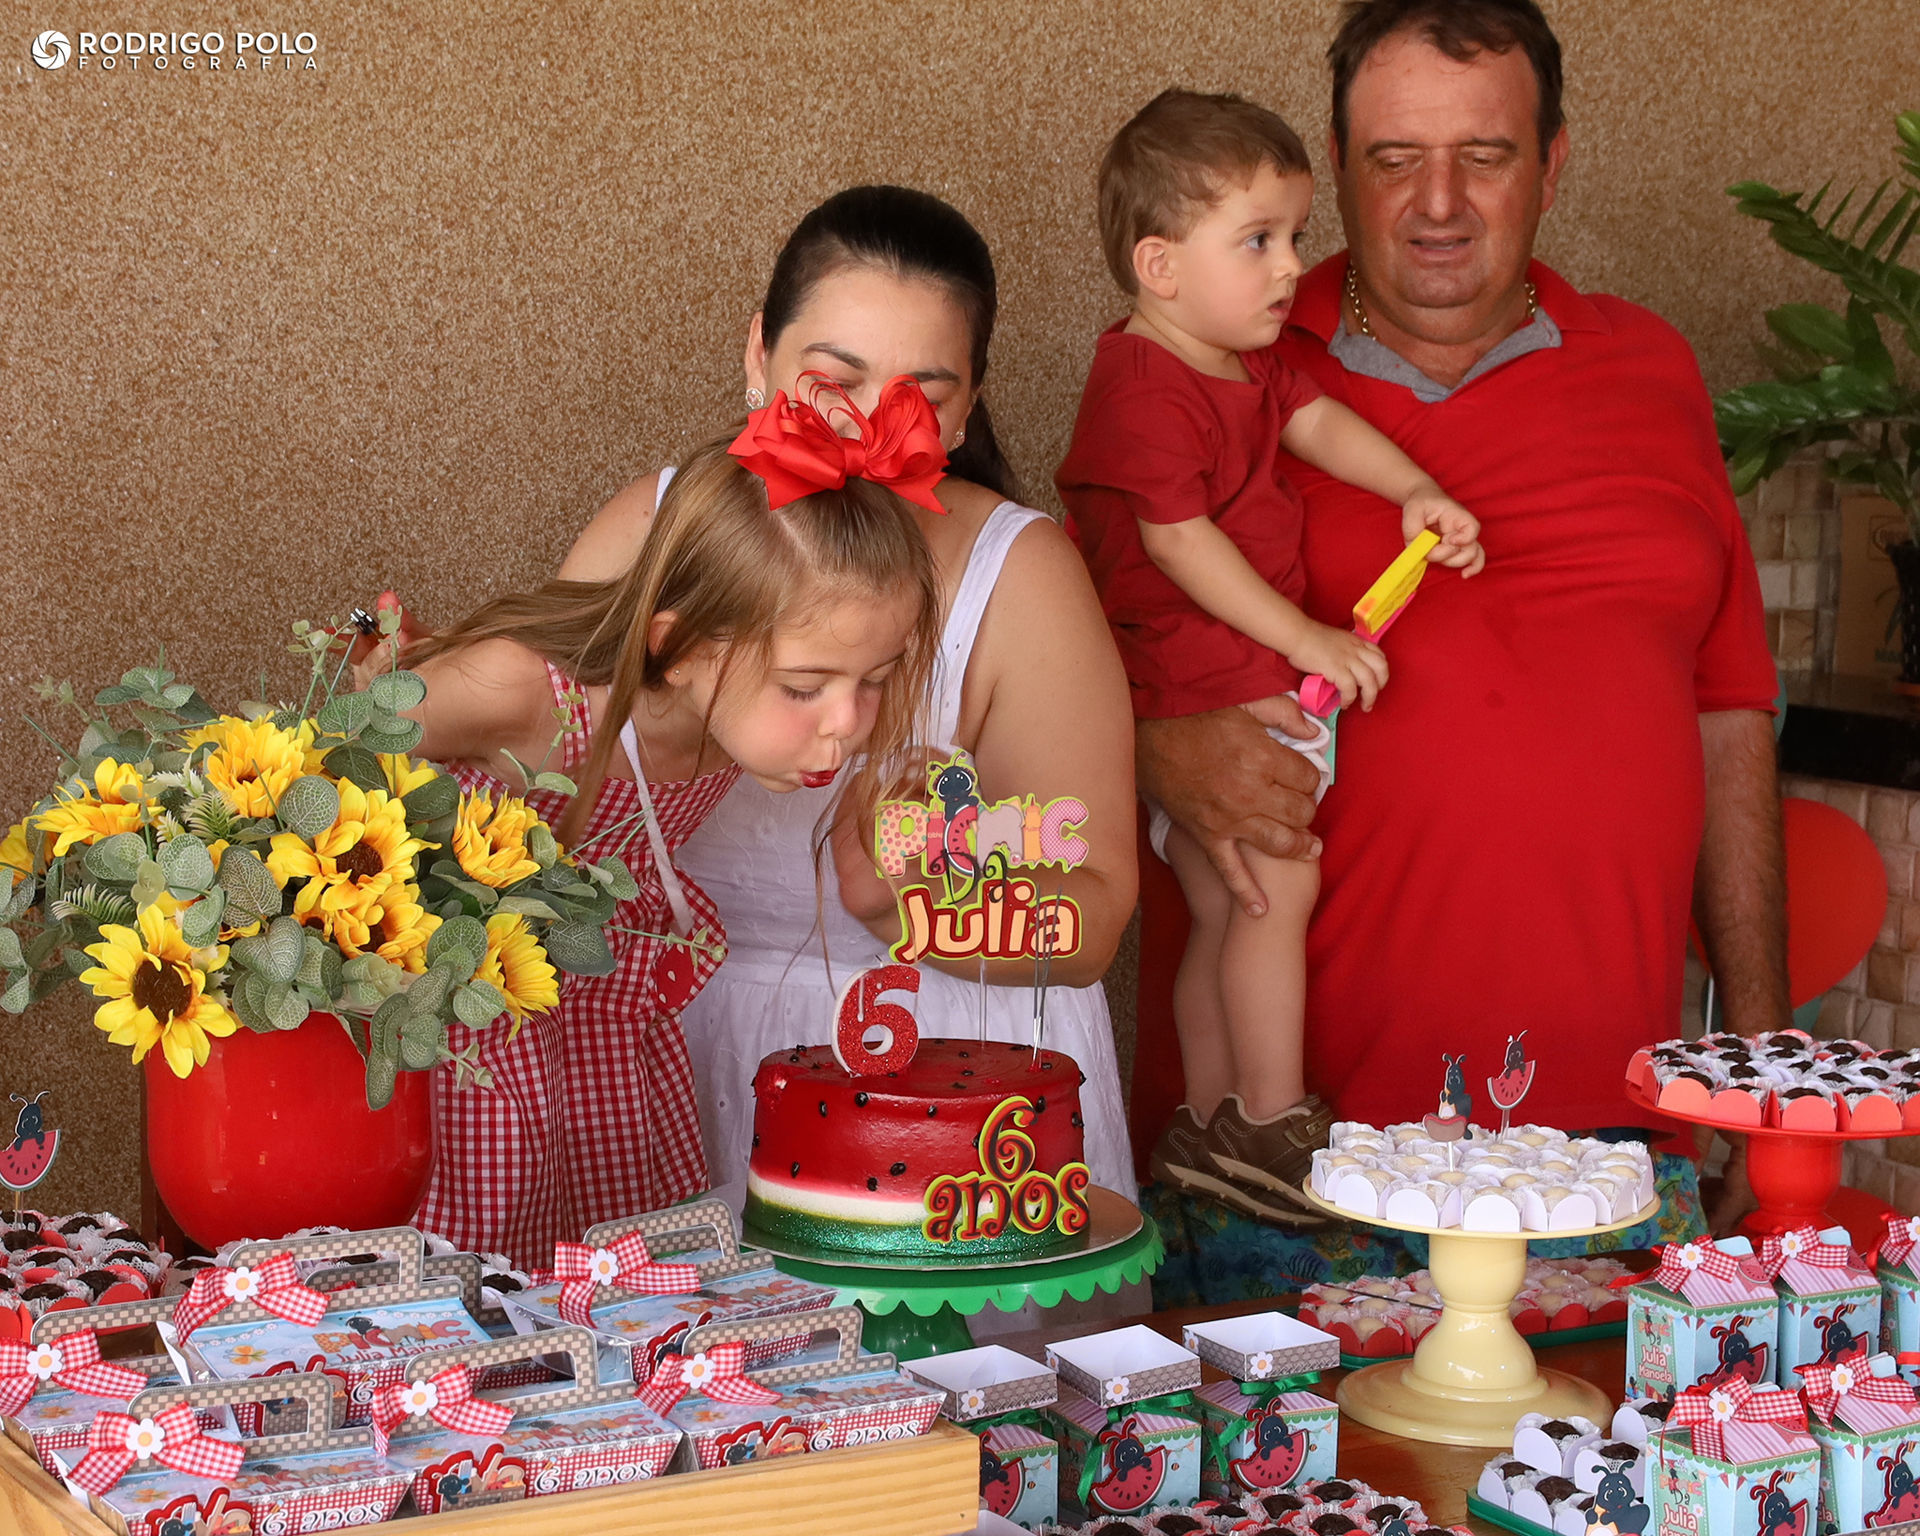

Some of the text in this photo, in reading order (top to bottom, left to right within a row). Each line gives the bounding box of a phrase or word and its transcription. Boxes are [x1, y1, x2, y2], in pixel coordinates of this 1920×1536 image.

[894, 879, 1081, 963] Julia
[833, 963, 921, 1077] 6
[979, 1096, 1038, 1183] 6
[923, 1163, 1092, 1243] anos
[1637, 1362, 1675, 1385] Manoela
[1640, 1344, 1668, 1368] Julia
[352, 1377, 378, 1405] 6
[809, 1424, 836, 1453] 6
[533, 1458, 656, 1495] 6 anos
[259, 1499, 386, 1536] 6 anos
[1663, 1502, 1699, 1532] Julia
